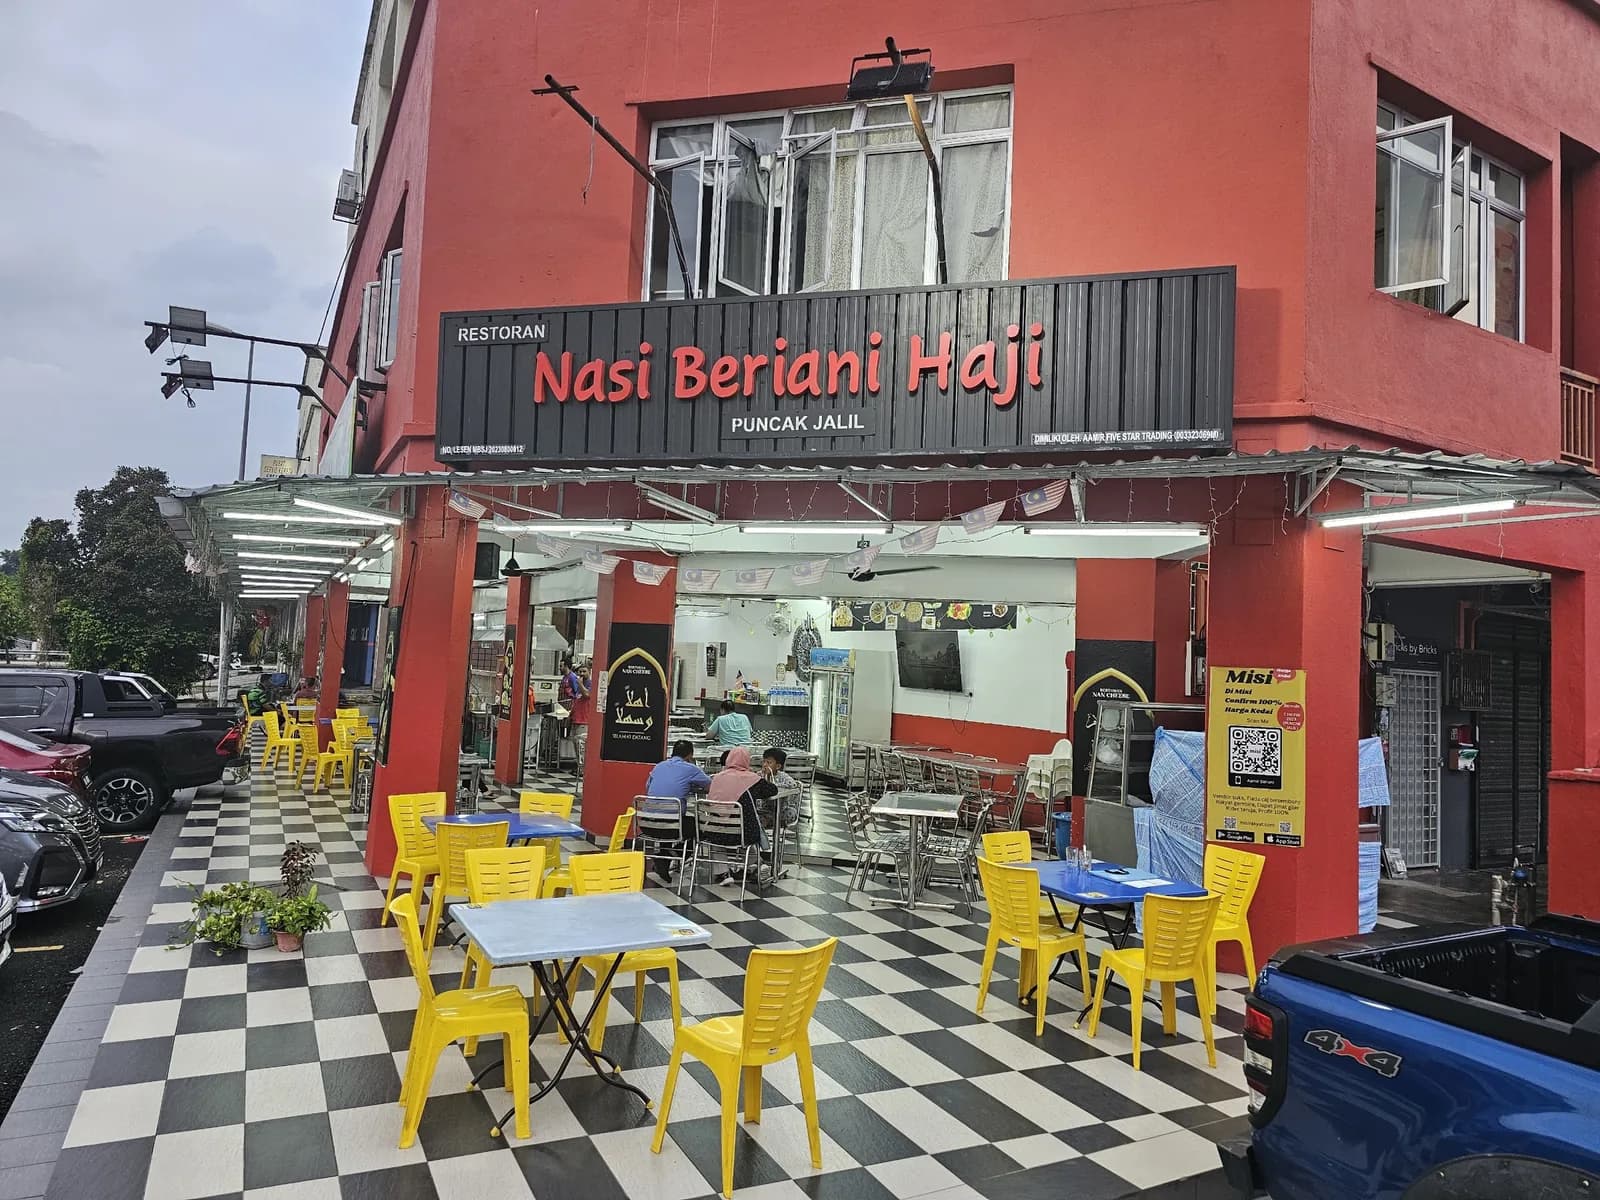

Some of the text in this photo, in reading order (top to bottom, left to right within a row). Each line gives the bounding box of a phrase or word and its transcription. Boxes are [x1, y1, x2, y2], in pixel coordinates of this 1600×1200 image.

[458, 324, 546, 342] RESTORAN
[533, 323, 1043, 406] Nasi Beriani Haji
[731, 413, 865, 433] PUNCAK JALIL
[1106, 431, 1121, 442] FIVE
[1122, 431, 1140, 441] STAR
[1142, 431, 1173, 441] TRADING
[1418, 644, 1438, 655] Bricks
[1226, 670, 1274, 684] Misi
[1225, 697, 1257, 705] Confirm
